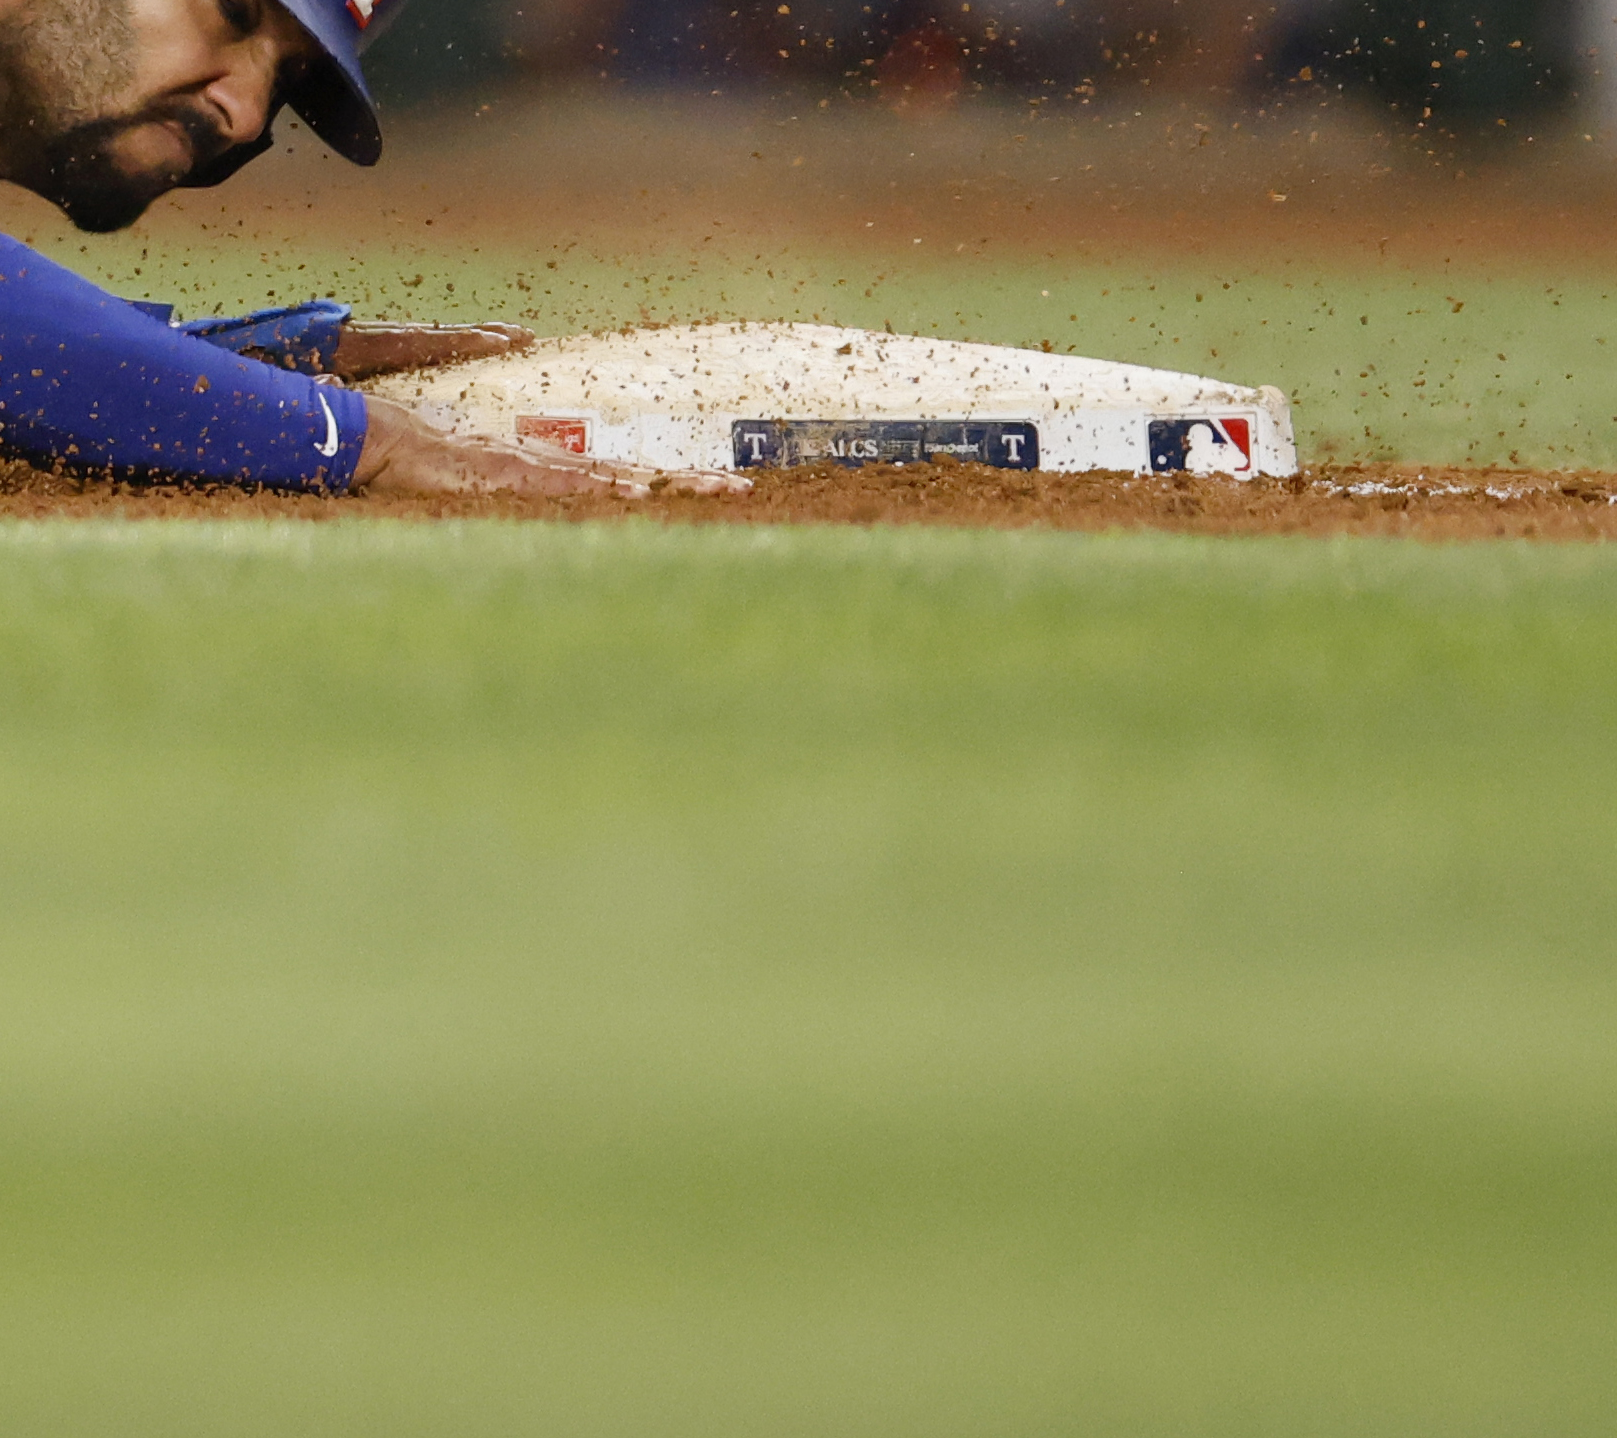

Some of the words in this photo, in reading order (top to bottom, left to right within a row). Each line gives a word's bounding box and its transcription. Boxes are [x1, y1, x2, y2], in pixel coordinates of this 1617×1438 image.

[743, 432, 767, 460] T
[824, 438, 880, 459] ALCS
[1000, 433, 1026, 462] T
